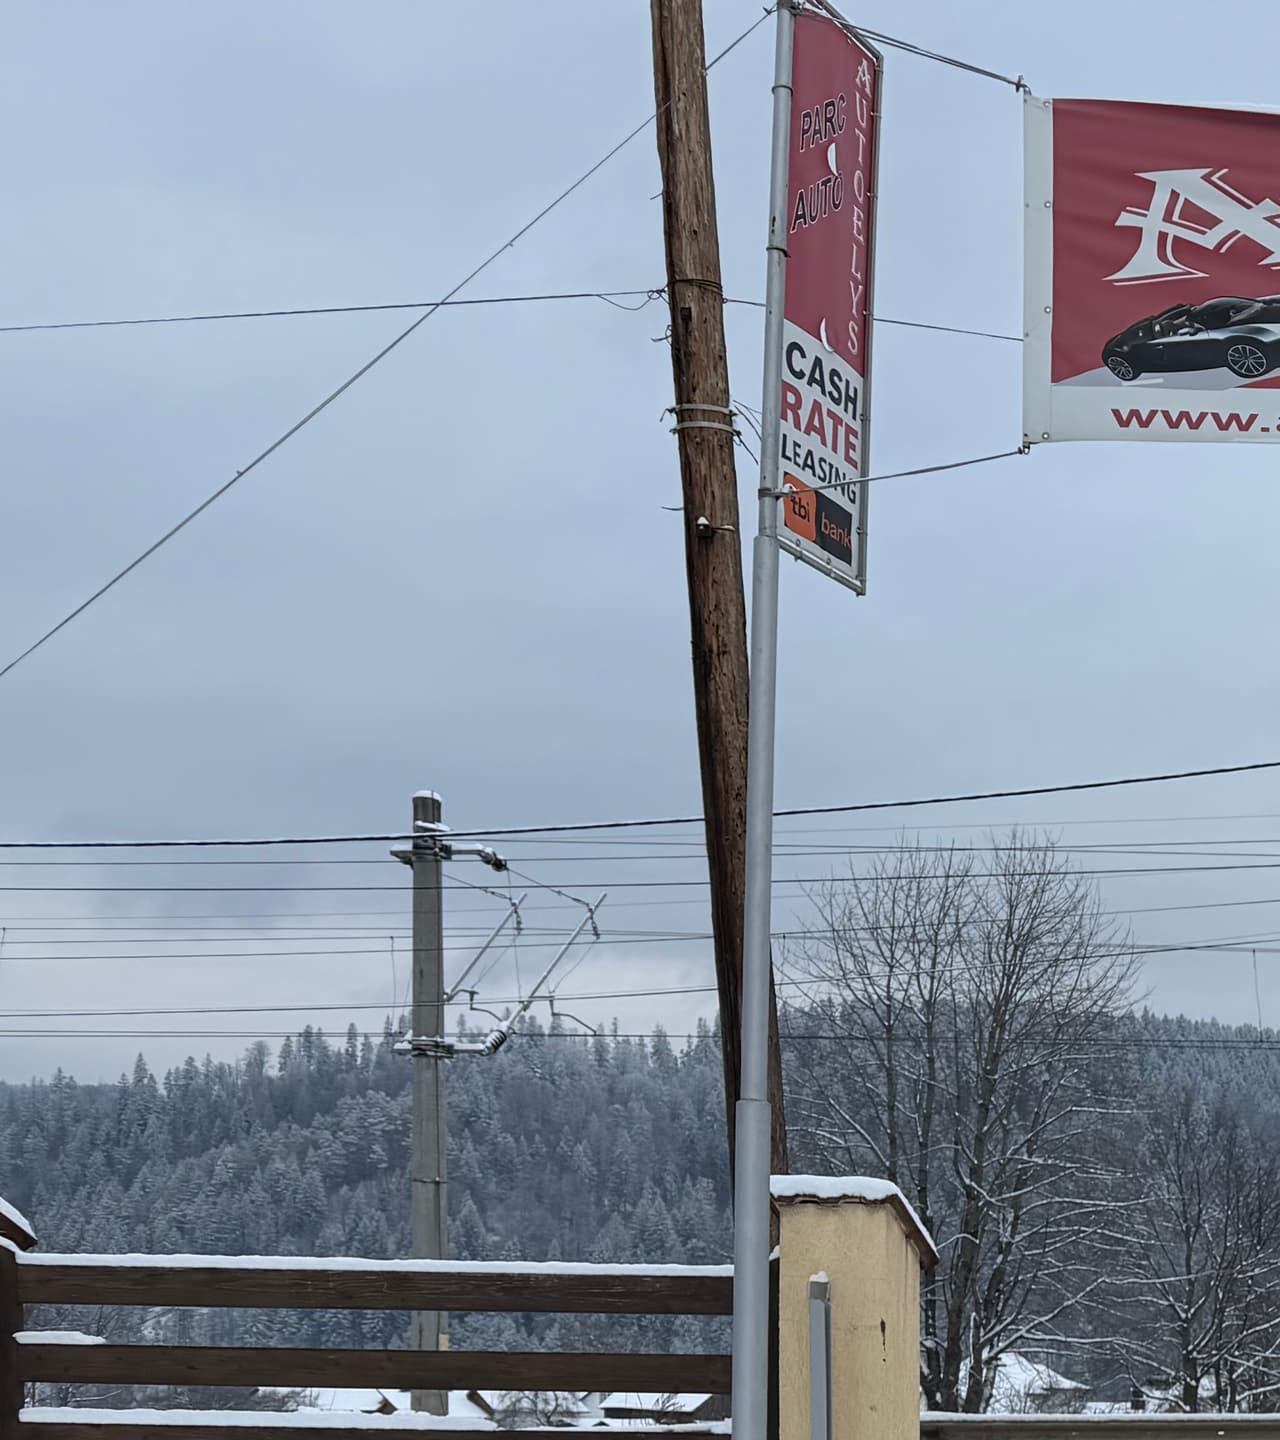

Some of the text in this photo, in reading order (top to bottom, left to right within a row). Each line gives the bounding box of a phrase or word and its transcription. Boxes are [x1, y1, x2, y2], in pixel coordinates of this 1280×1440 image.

[800, 93, 846, 152] PARC
[790, 170, 843, 234] AUTO
[785, 341, 858, 421] CASH
[780, 379, 859, 470] RATE
[781, 433, 857, 505] LEASING
[790, 495, 852, 550] tbi bank
